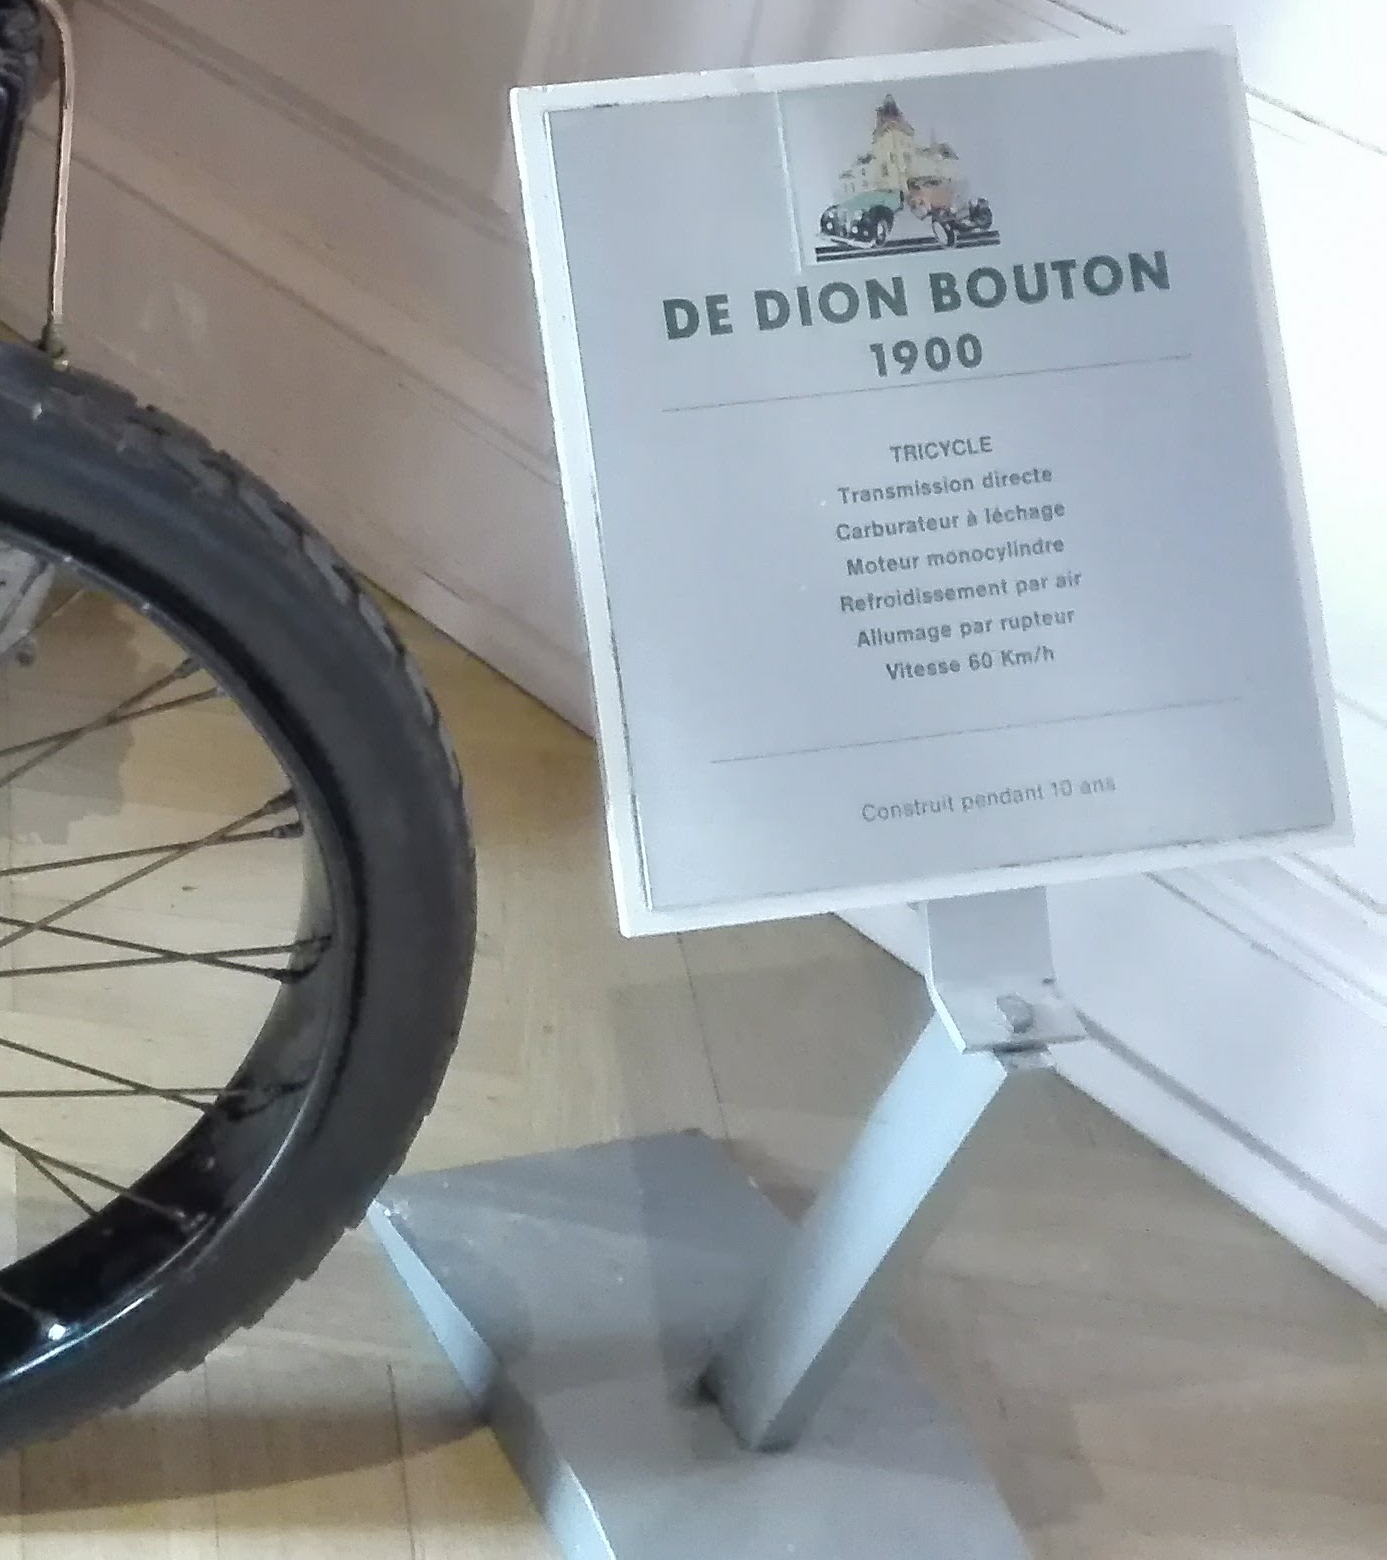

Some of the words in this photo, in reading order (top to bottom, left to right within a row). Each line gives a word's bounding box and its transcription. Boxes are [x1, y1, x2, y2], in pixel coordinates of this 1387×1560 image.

[662, 293, 734, 340] DE
[754, 276, 909, 331] DION
[929, 250, 1171, 314] BOUTON
[870, 333, 983, 378] 1900
[889, 435, 993, 463] TRICYCLE
[836, 475, 974, 504] Transmission
[982, 467, 1052, 490] directe
[835, 512, 959, 541] Carburateur
[967, 509, 978, 527] à
[985, 501, 1066, 525] léchage
[846, 554, 919, 576] Moteur
[927, 536, 1064, 567] monocylindre
[840, 578, 1008, 612] Refroidissement
[1015, 575, 1048, 597] par
[1056, 569, 1082, 588] air
[857, 623, 952, 648] Allumage
[960, 616, 993, 638] par
[1000, 608, 1075, 632] rupteur
[885, 658, 961, 680] Vitesse
[968, 651, 994, 672] 60
[1001, 644, 1055, 667] Km/h
[861, 794, 954, 822] Construit
[961, 784, 1044, 813] pendant
[1050, 779, 1073, 797] 10
[1080, 775, 1116, 795] ans
